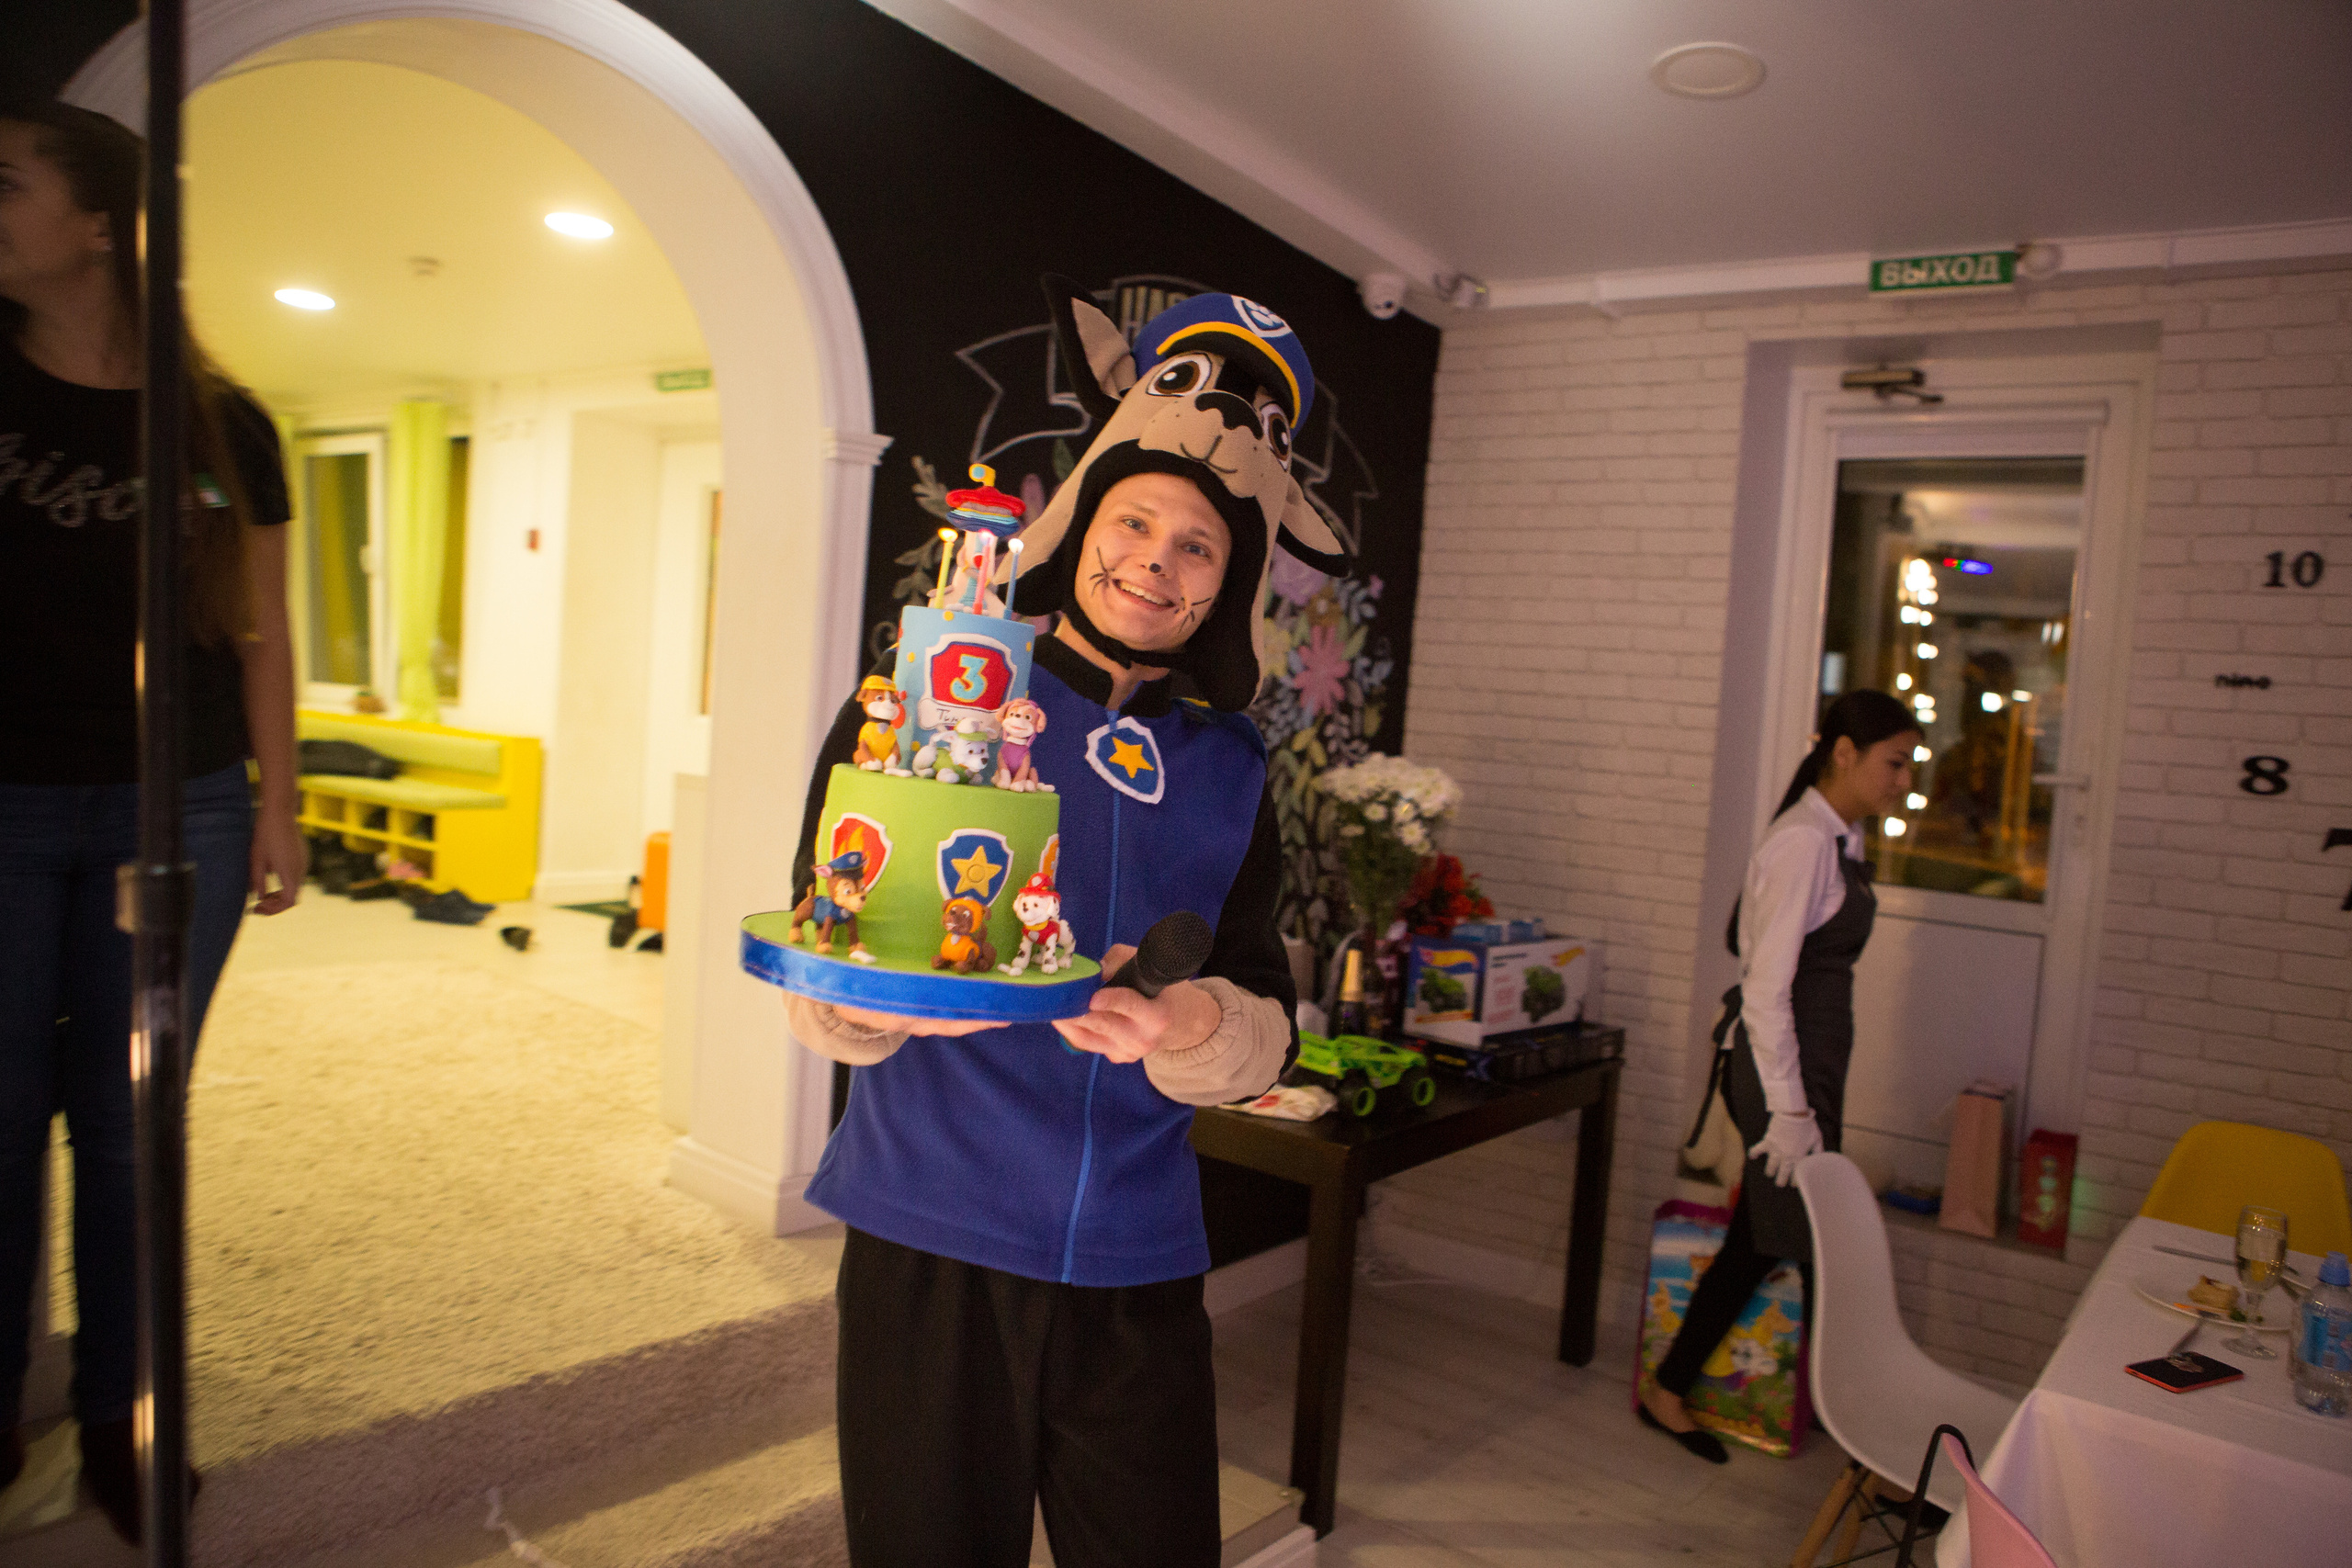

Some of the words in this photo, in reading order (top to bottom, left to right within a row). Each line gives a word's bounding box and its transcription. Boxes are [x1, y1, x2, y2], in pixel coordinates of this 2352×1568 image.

[1880, 254, 2000, 287] ВЫХОД
[2263, 551, 2324, 588] 10
[950, 654, 989, 703] 3
[2239, 755, 2290, 796] 8
